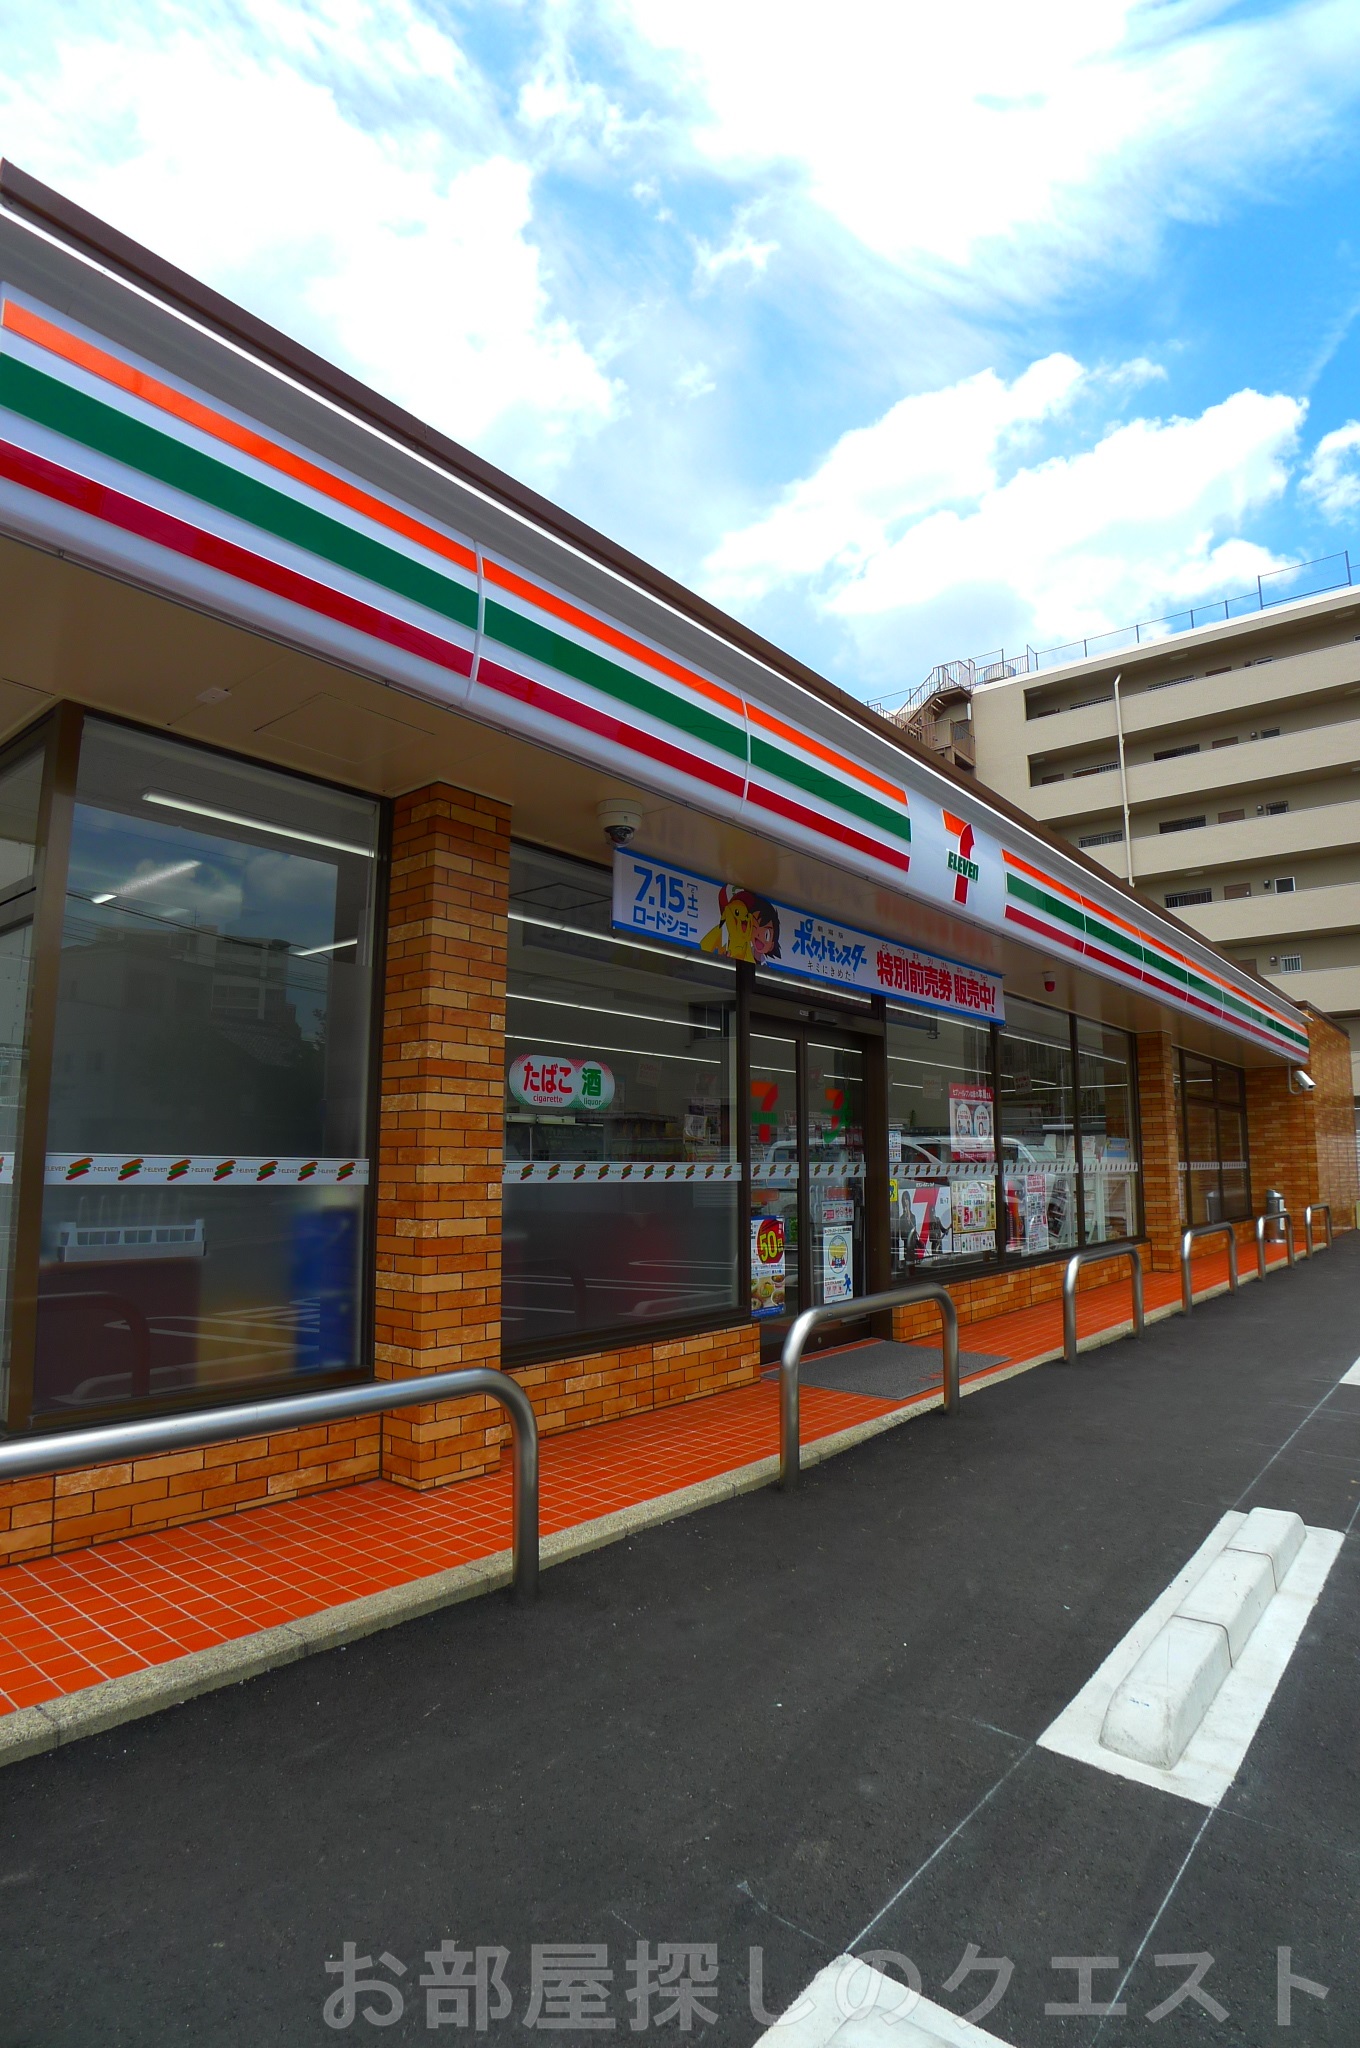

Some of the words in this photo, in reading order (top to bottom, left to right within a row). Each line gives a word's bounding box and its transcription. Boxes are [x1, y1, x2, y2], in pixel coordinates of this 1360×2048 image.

[941, 808, 975, 906] 7
[634, 864, 685, 914] 7.15
[633, 905, 698, 938] ロードショー
[792, 919, 868, 972] ポケットモンスター
[877, 950, 953, 1002] 特別前売券
[954, 974, 996, 1014] 販売中!
[524, 1062, 573, 1093] たばこ
[582, 1067, 602, 1097] 酒
[533, 1094, 563, 1104] cigarette
[583, 1098, 602, 1107] liquor
